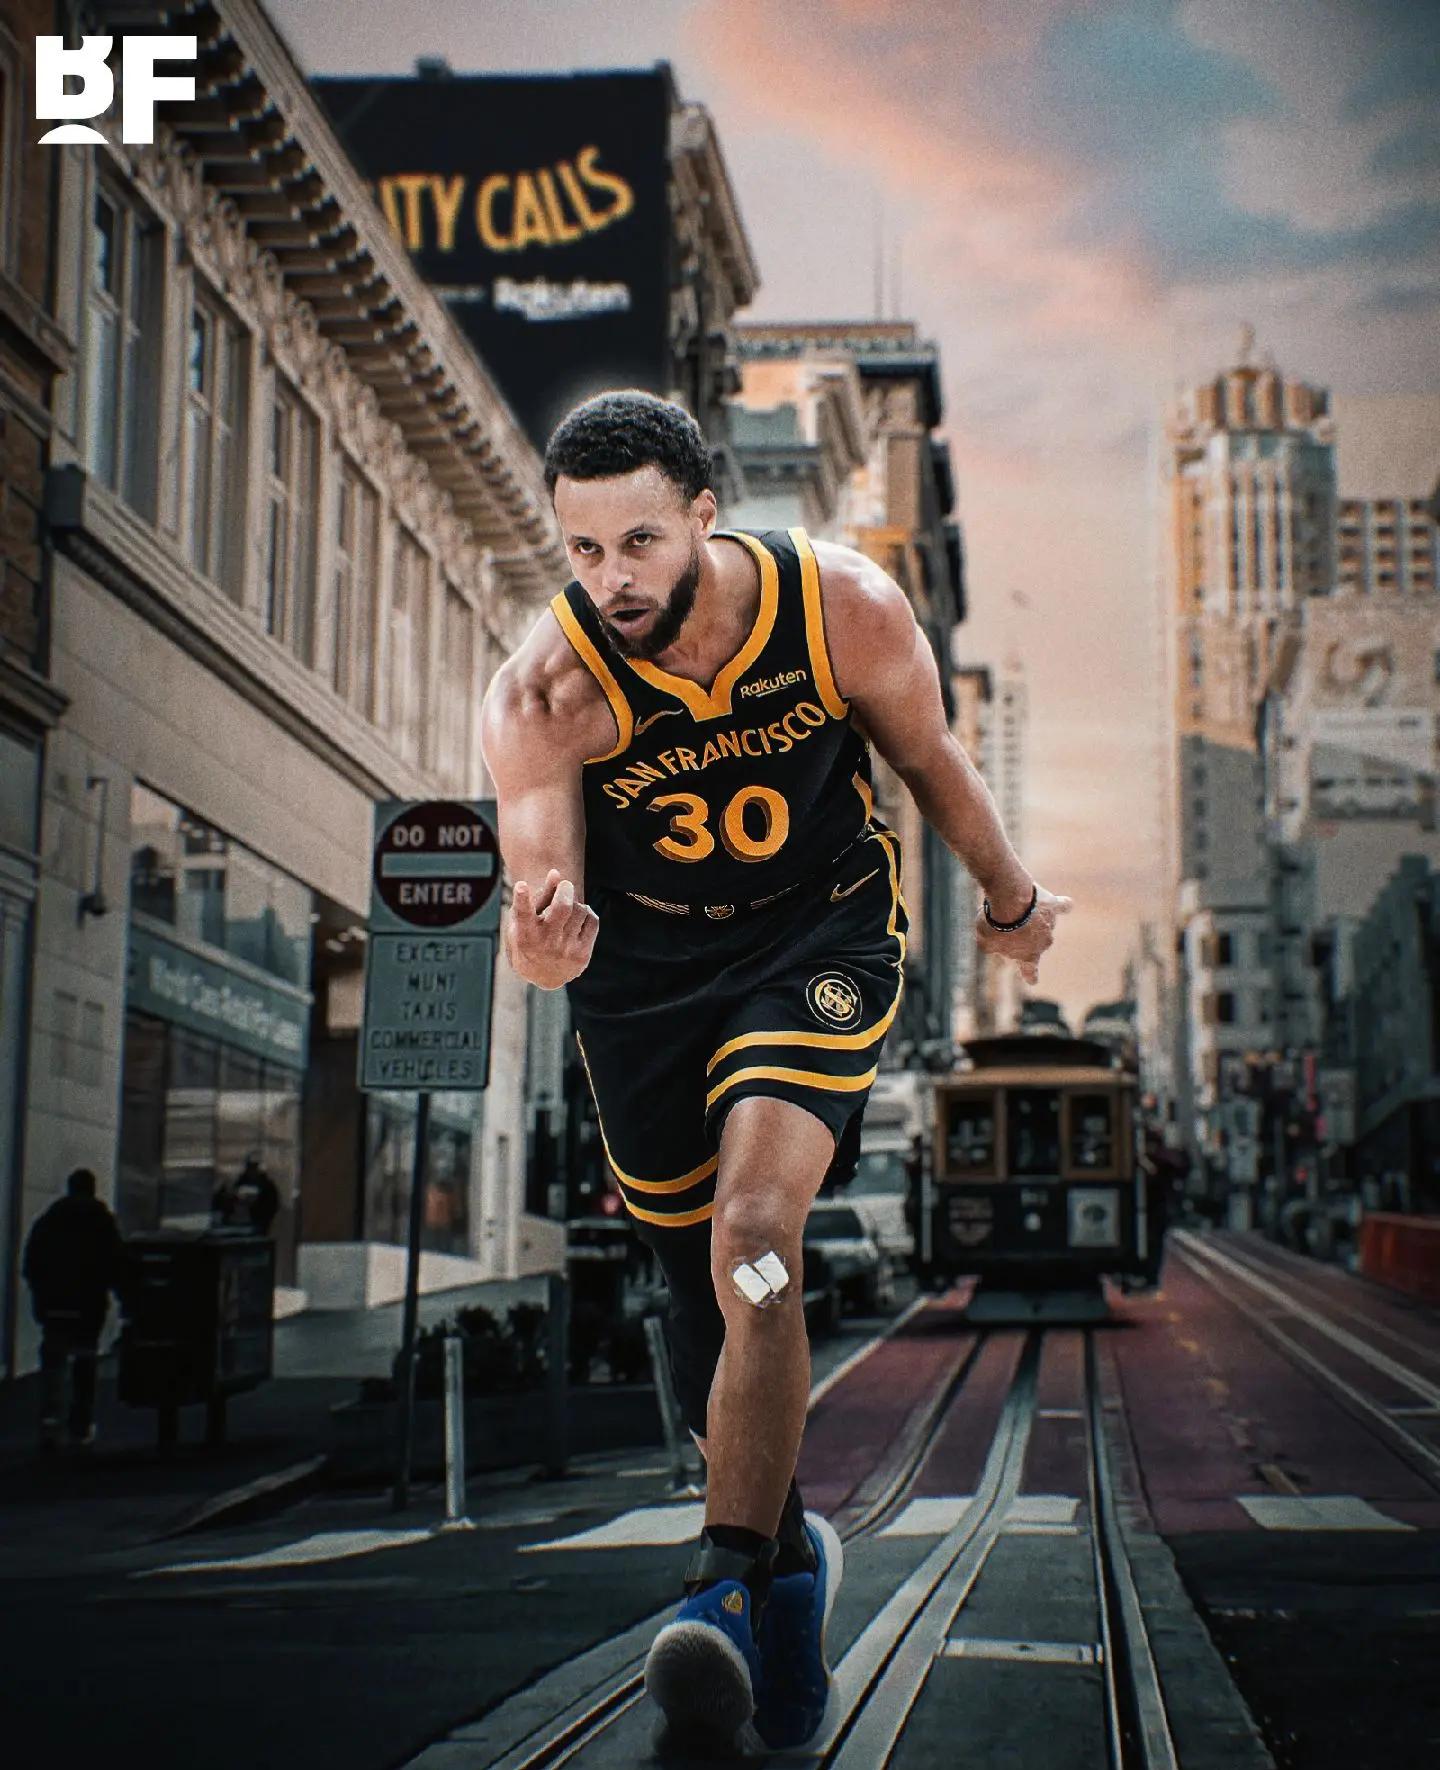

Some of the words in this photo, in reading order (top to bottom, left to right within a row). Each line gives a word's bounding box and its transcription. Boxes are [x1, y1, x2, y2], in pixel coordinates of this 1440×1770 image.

[376, 173, 466, 251] ITY
[475, 145, 634, 251] CALLS
[740, 669, 807, 699] Rakuten
[603, 761, 667, 808] SAN
[657, 702, 826, 776] FRANCISCO
[392, 825, 425, 846] DO
[438, 825, 483, 846] NOT
[646, 786, 789, 863] 30
[399, 883, 472, 905] ENTER
[397, 942, 470, 962] EXCEPT
[402, 1002, 457, 1021] TAXIS
[371, 1030, 481, 1050] COMMERCIAL
[377, 1058, 473, 1081] VEHICLES
